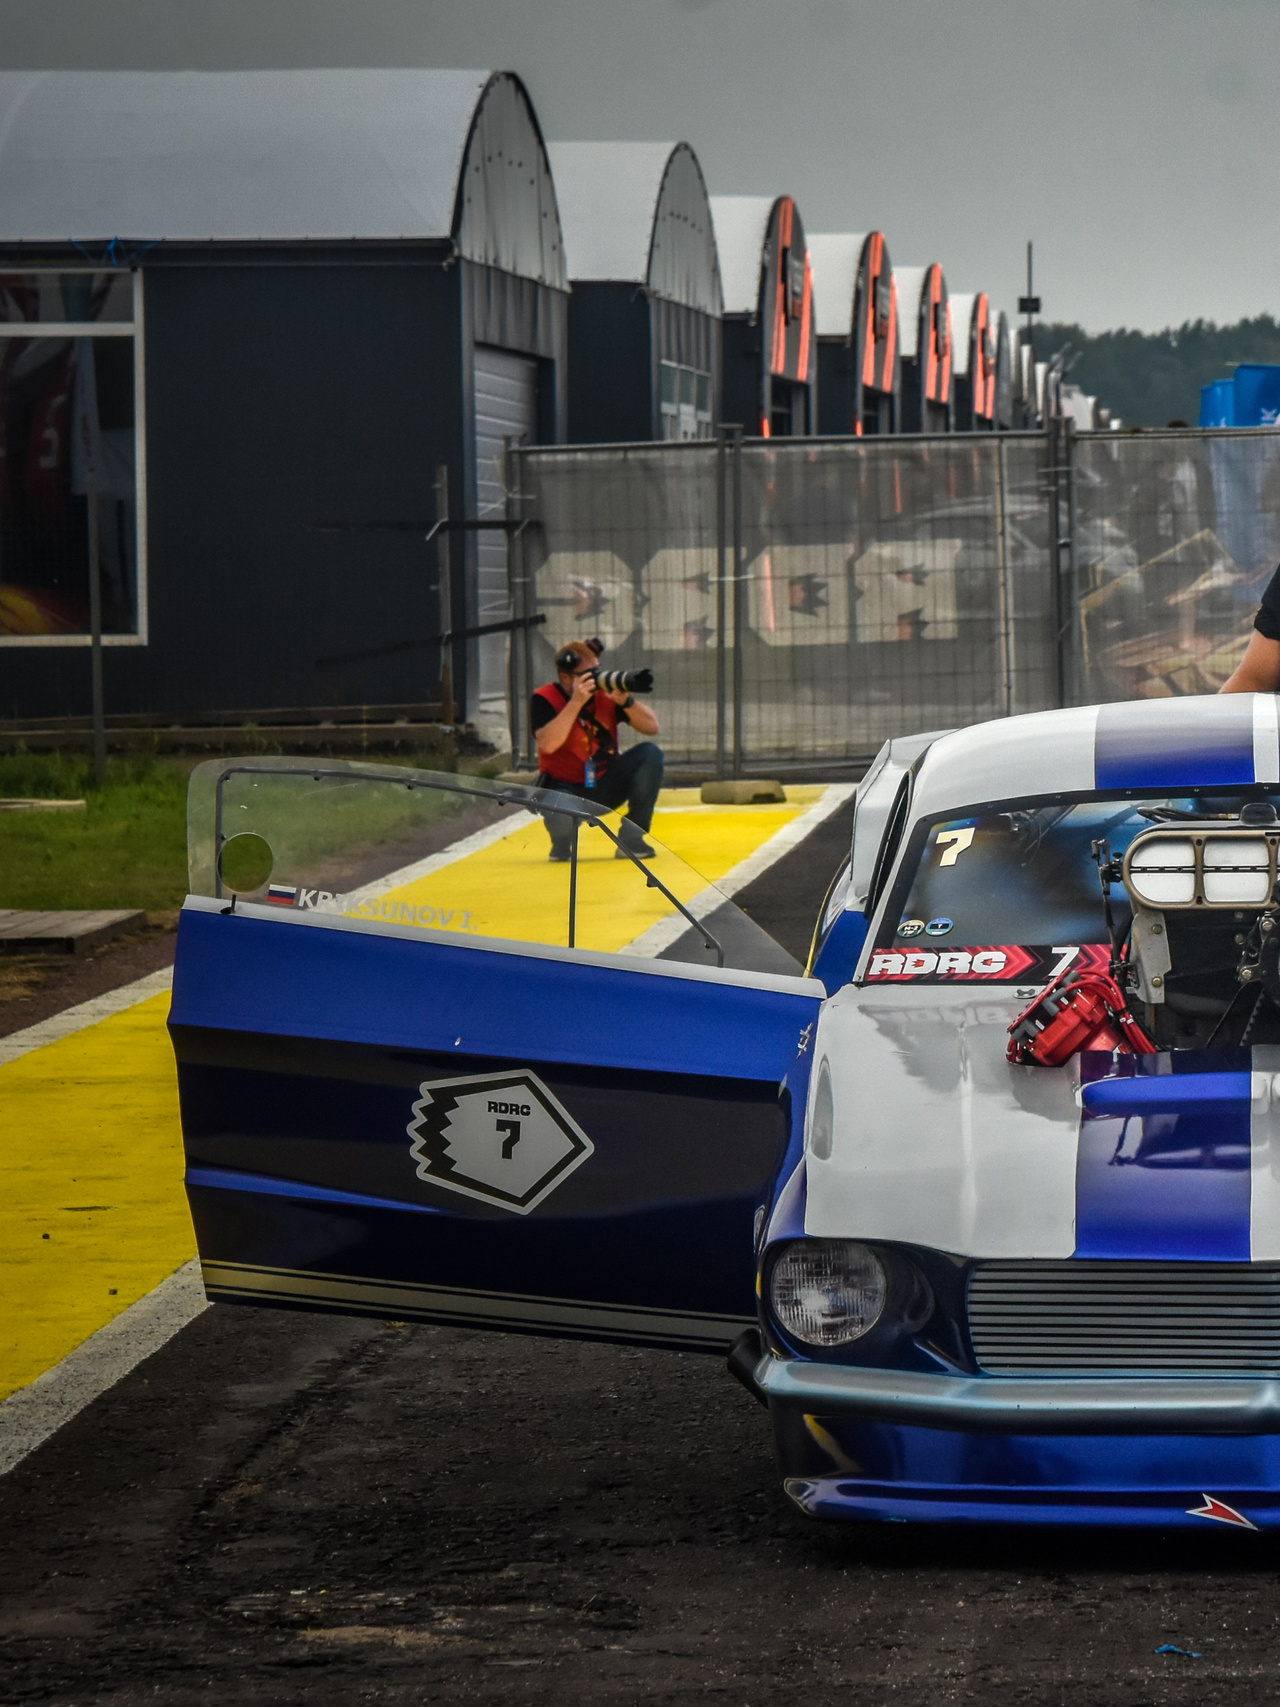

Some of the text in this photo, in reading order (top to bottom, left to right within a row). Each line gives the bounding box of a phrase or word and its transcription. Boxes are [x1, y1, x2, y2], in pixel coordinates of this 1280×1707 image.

[936, 827, 975, 866] 7
[460, 911, 478, 931] I.
[869, 947, 1079, 976] RDRC 7
[487, 1100, 531, 1117] RDRC
[496, 1119, 521, 1160] 7
